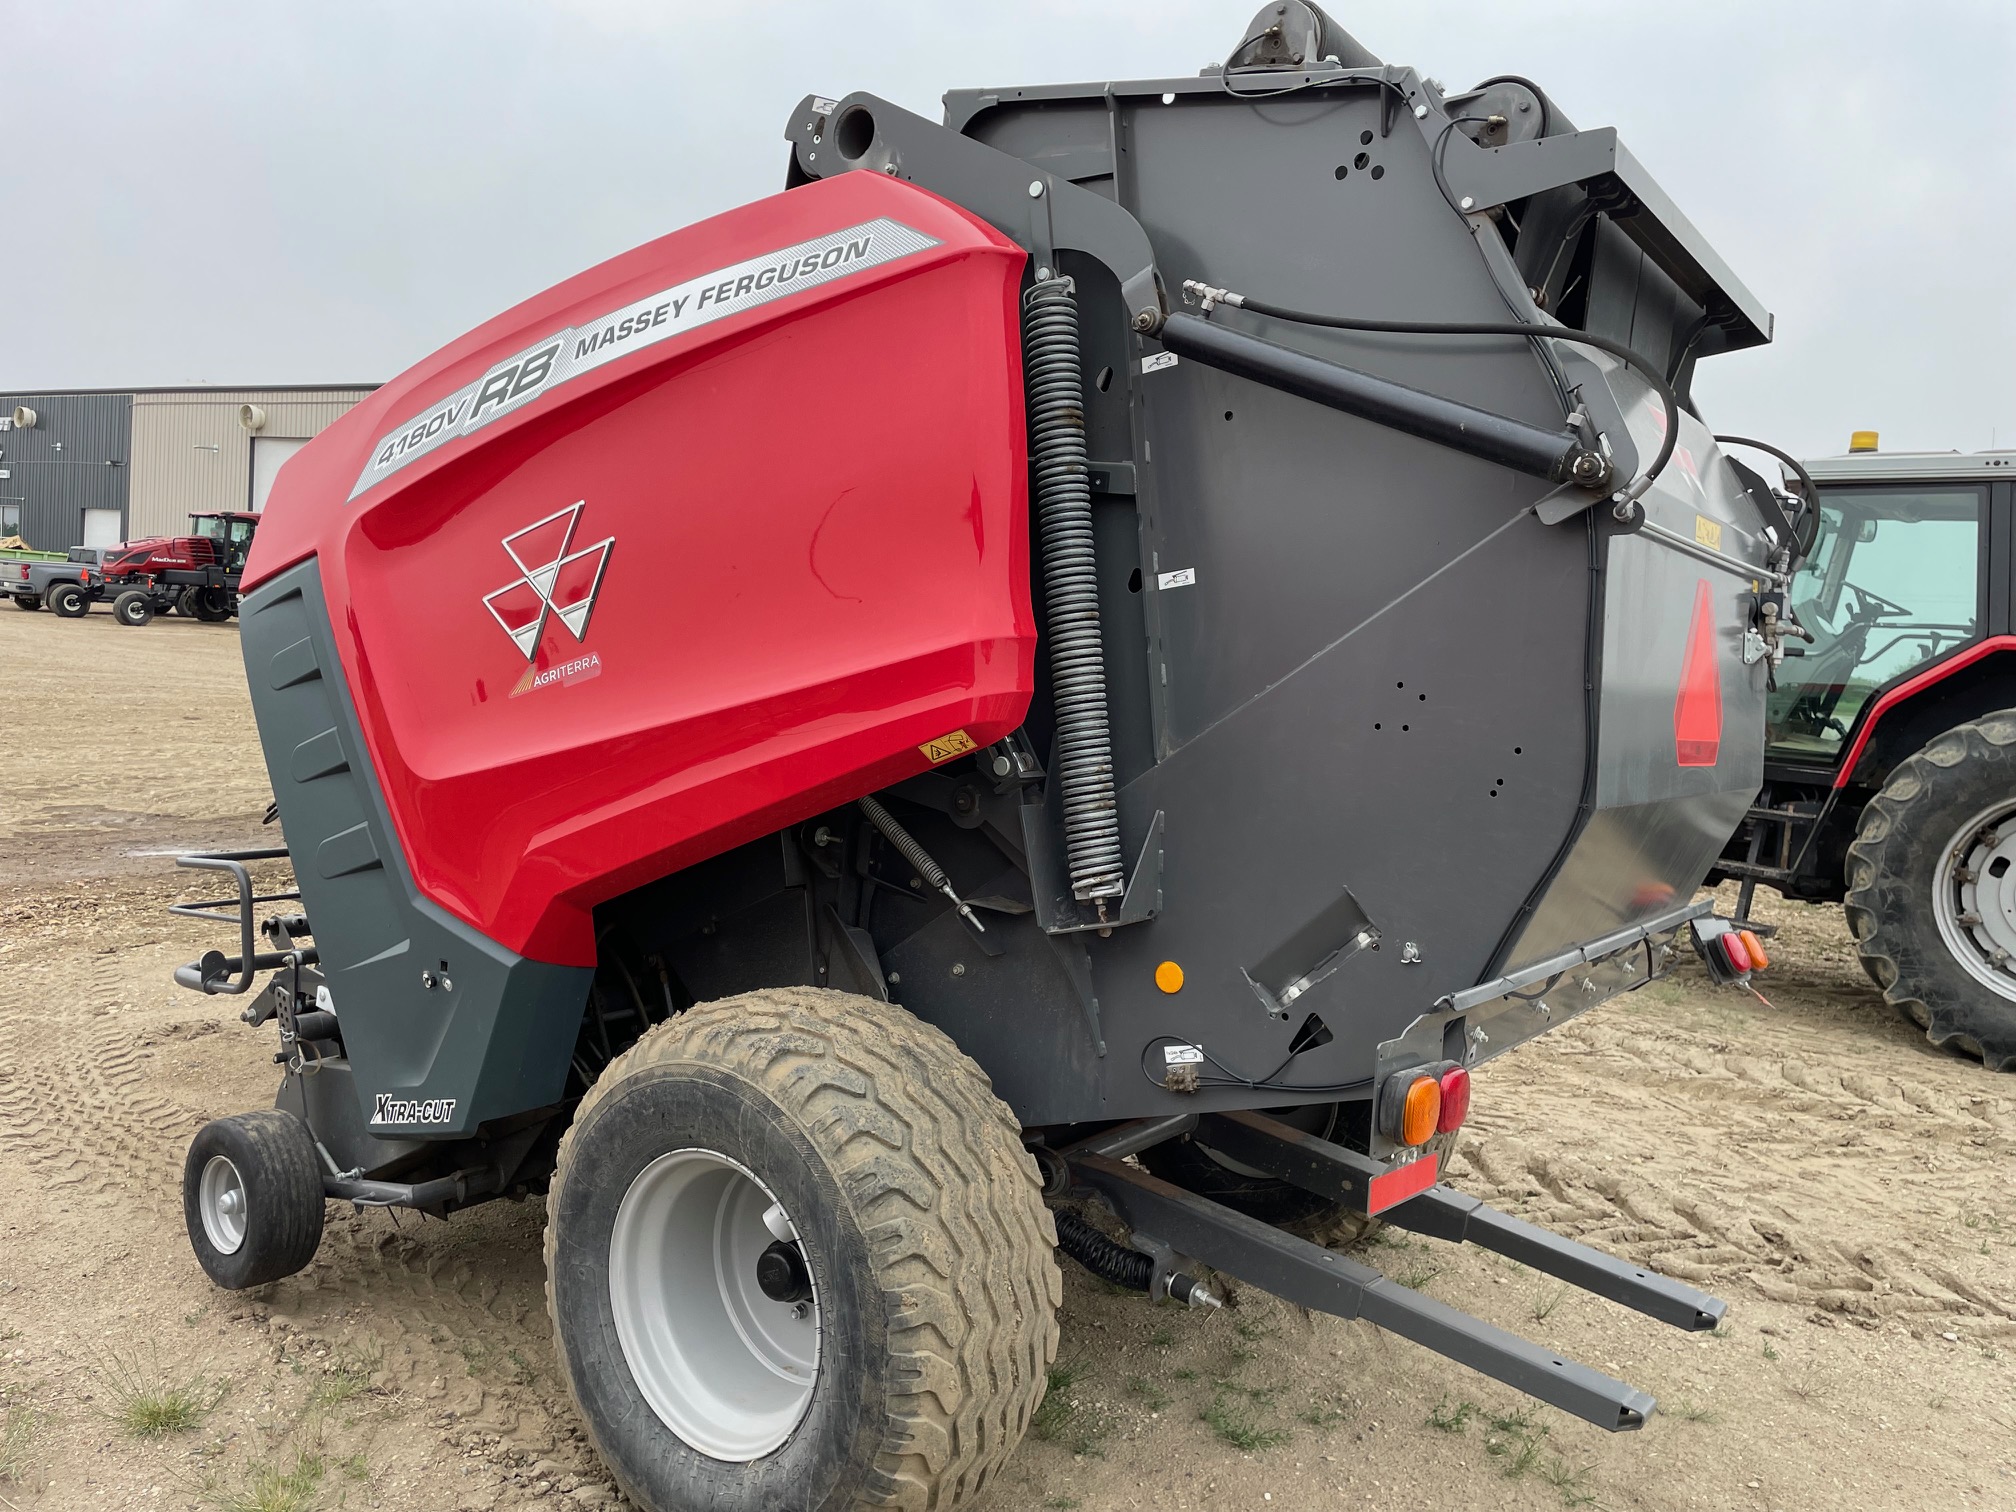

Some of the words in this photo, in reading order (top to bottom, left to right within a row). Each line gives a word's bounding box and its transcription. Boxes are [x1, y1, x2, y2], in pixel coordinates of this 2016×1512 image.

[376, 399, 469, 468] 4180V
[468, 342, 561, 420] RB
[574, 295, 690, 360] MASSEY
[698, 237, 872, 310] FERGUSON
[533, 655, 600, 688] AGRITERRA
